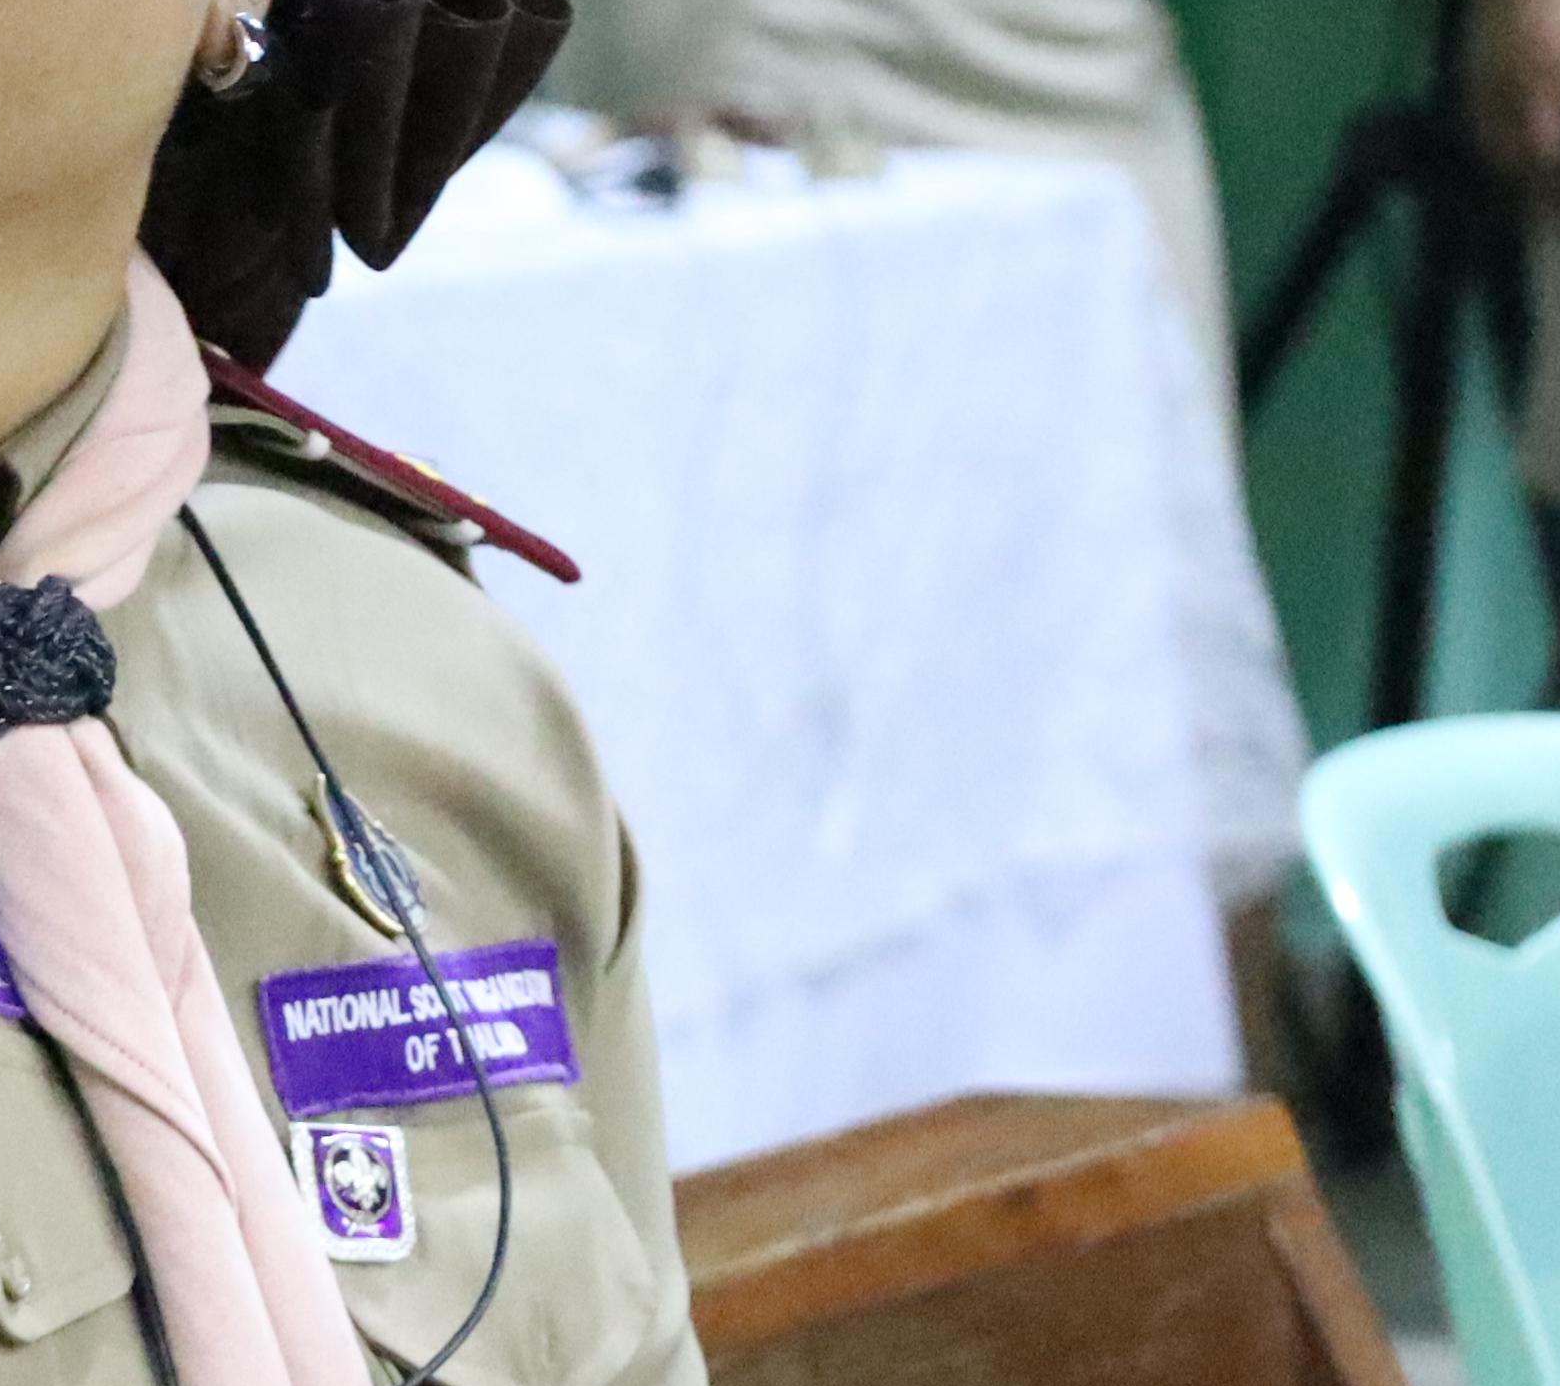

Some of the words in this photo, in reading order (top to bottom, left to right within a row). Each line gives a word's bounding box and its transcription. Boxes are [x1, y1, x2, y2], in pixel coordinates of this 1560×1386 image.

[282, 986, 413, 1042] NATIONAL
[410, 979, 470, 1023] SCT
[404, 1032, 441, 1073] OF
